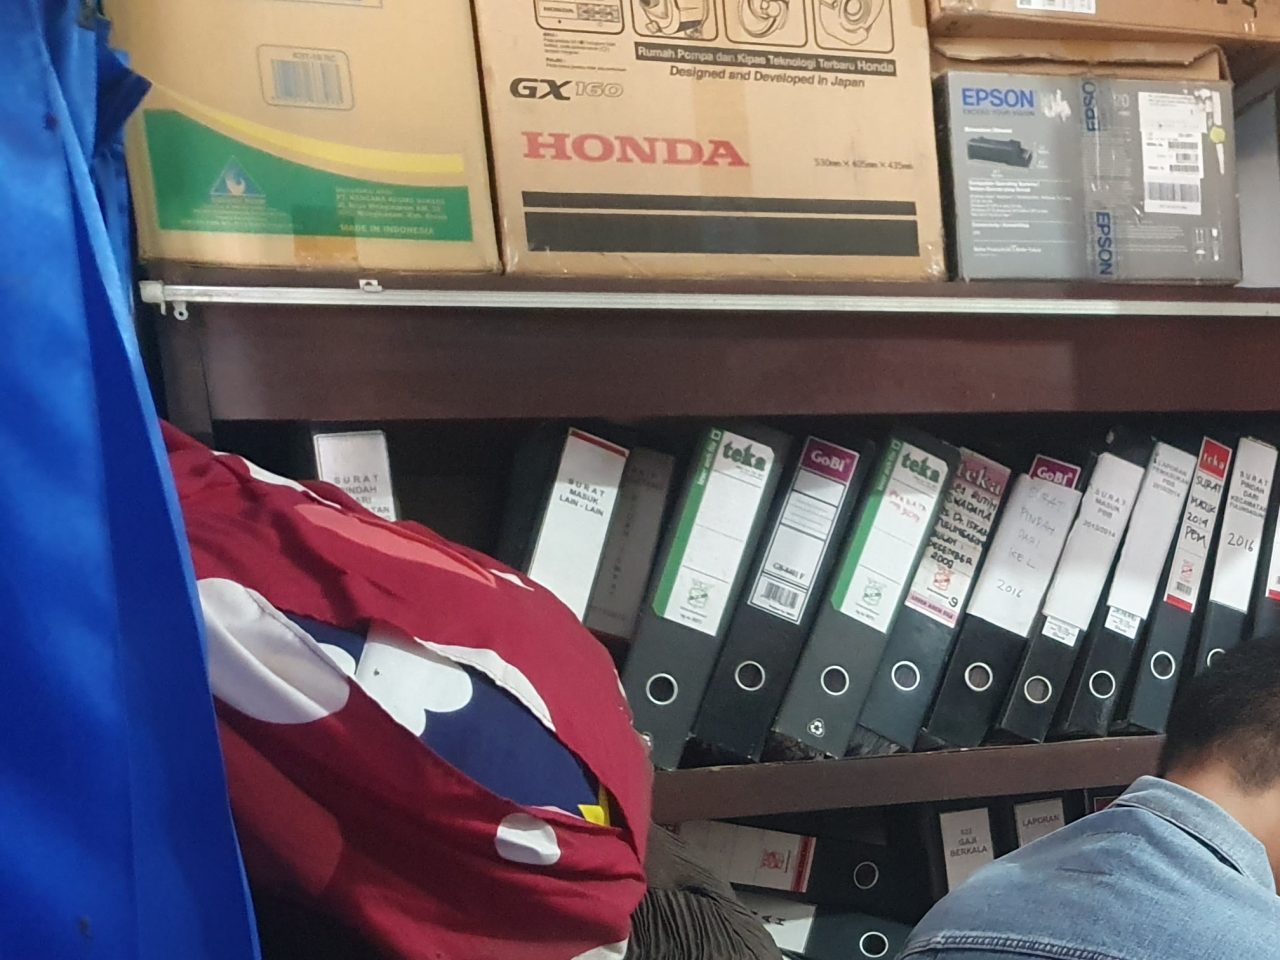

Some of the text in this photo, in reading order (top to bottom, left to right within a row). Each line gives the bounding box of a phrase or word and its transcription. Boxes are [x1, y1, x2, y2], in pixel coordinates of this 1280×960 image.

[638, 46, 895, 73] Rumah Pompa dan Kipas Teknologi Terbaru Honda
[670, 65, 725, 80] Designed
[729, 70, 750, 81] and
[753, 73, 815, 86] Developed
[830, 77, 866, 88] Japan
[962, 87, 1035, 108] EPSON
[521, 131, 749, 167] HONDA
[1096, 211, 1113, 275] EPSON
[723, 441, 766, 471] teka
[1203, 453, 1225, 470] teka
[901, 452, 941, 484] teka
[334, 475, 378, 484] SURAT
[568, 478, 605, 497] SURAT
[559, 494, 578, 507] LAIN
[585, 504, 604, 516] LAIN
[569, 489, 598, 505] MASUK
[1227, 532, 1255, 552] 2016
[997, 579, 1024, 598] 2016
[1022, 815, 1060, 827] LAPORAN
[950, 846, 987, 857] BERKALA
